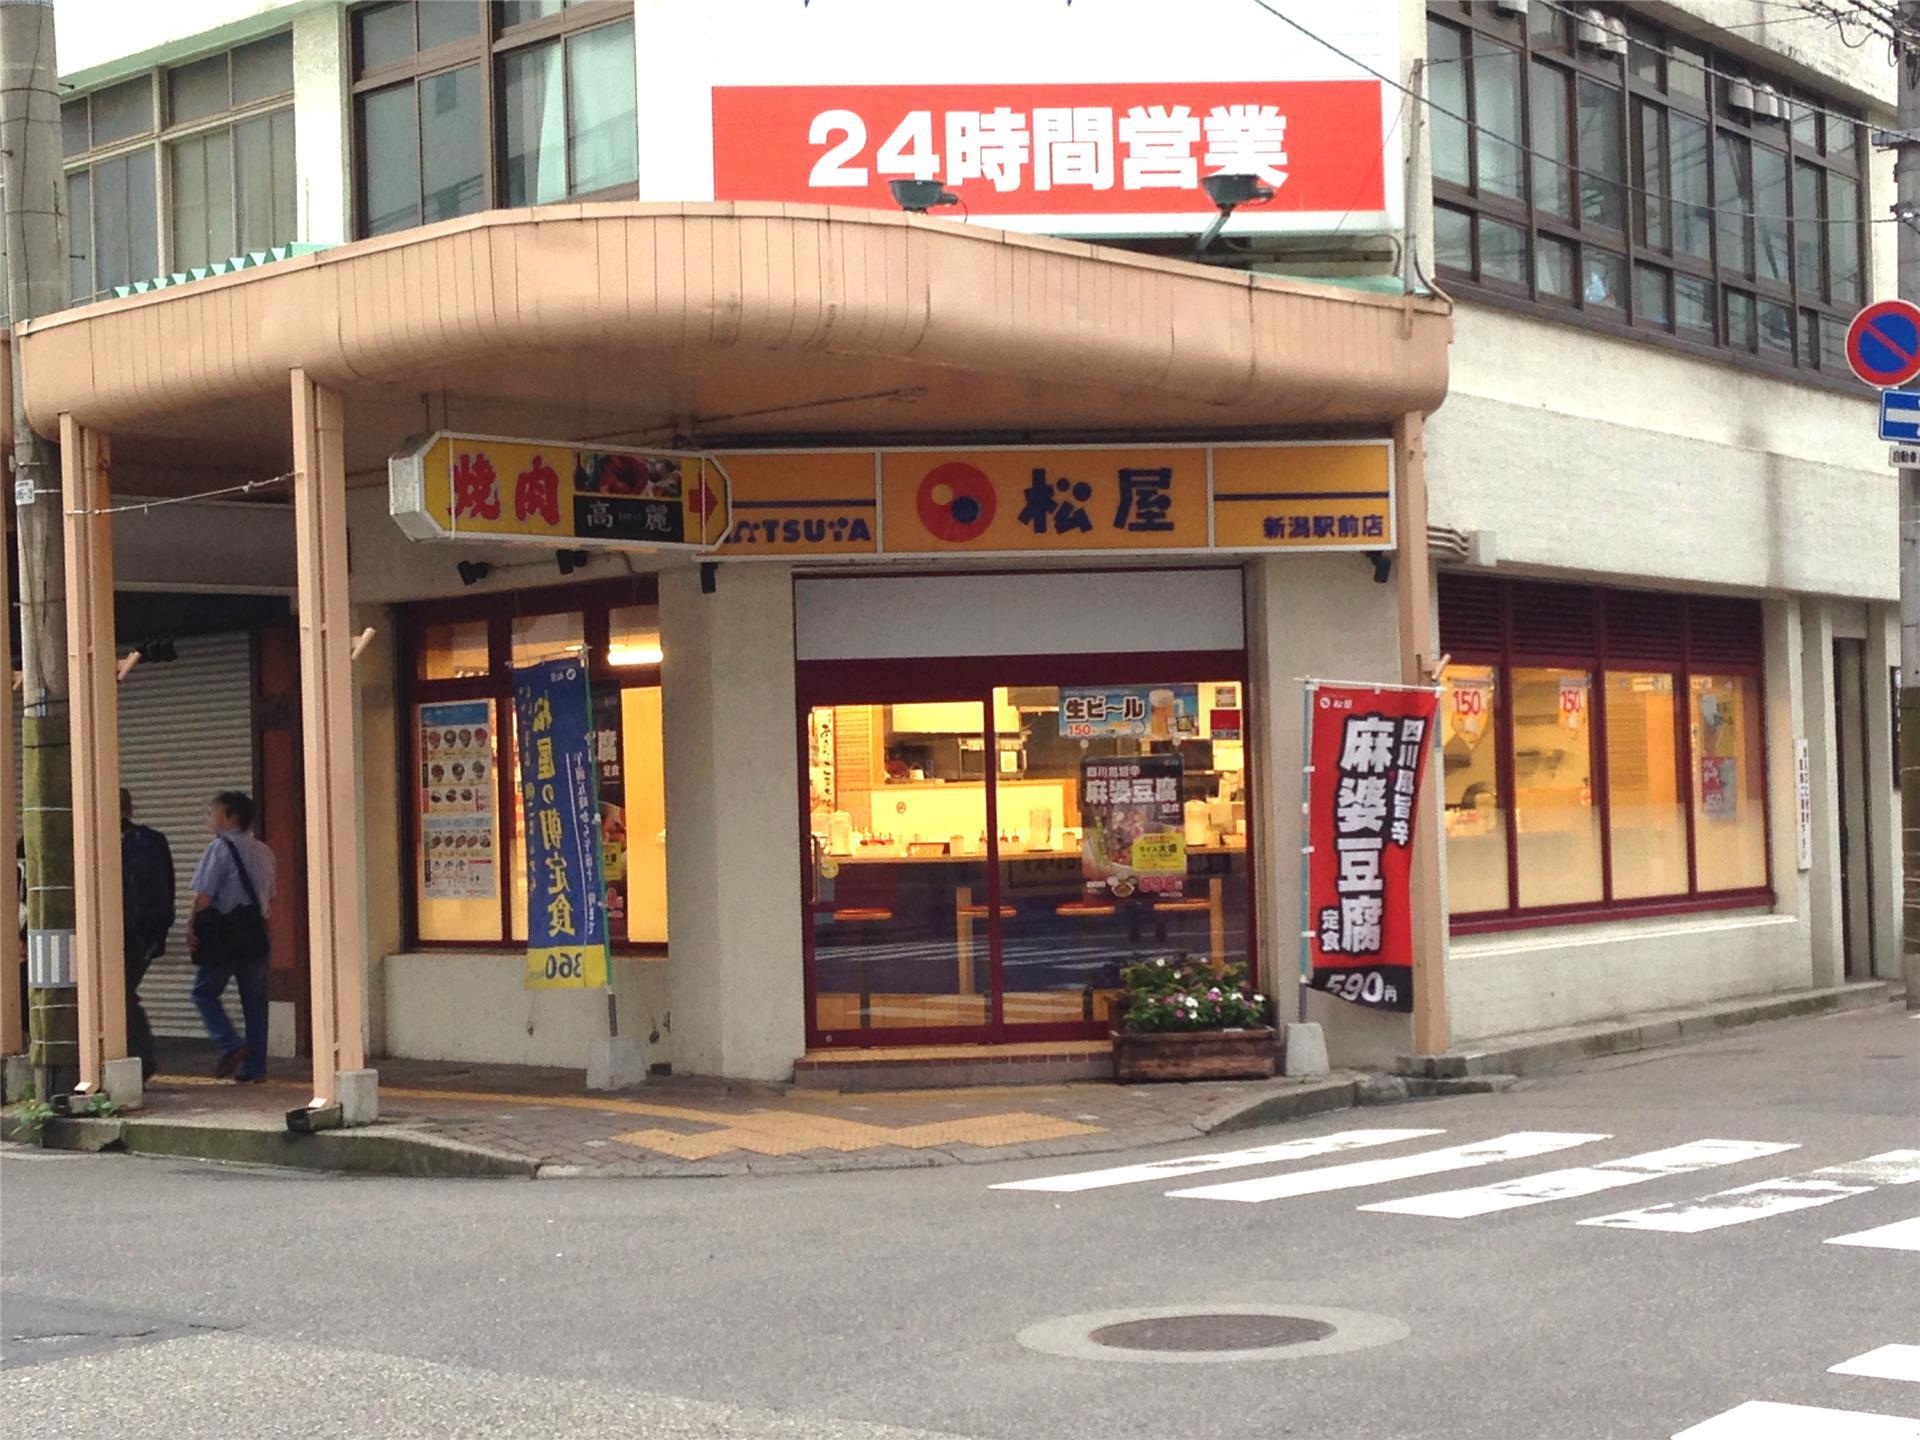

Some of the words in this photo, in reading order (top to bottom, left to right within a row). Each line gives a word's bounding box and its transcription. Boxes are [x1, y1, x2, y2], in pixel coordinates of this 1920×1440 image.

[808, 104, 1288, 191] 24時間営業
[447, 453, 559, 525] 焼肉
[1017, 467, 1174, 535] 松屋
[723, 517, 871, 544] ATSUYA
[1262, 514, 1384, 540] 新潟駅前店
[1453, 690, 1481, 714] 150
[1561, 689, 1580, 712] 150
[1086, 777, 1177, 804] 麻婆豆腐
[1336, 716, 1395, 953] 麻婆豆腐
[1321, 909, 1340, 951] 定食
